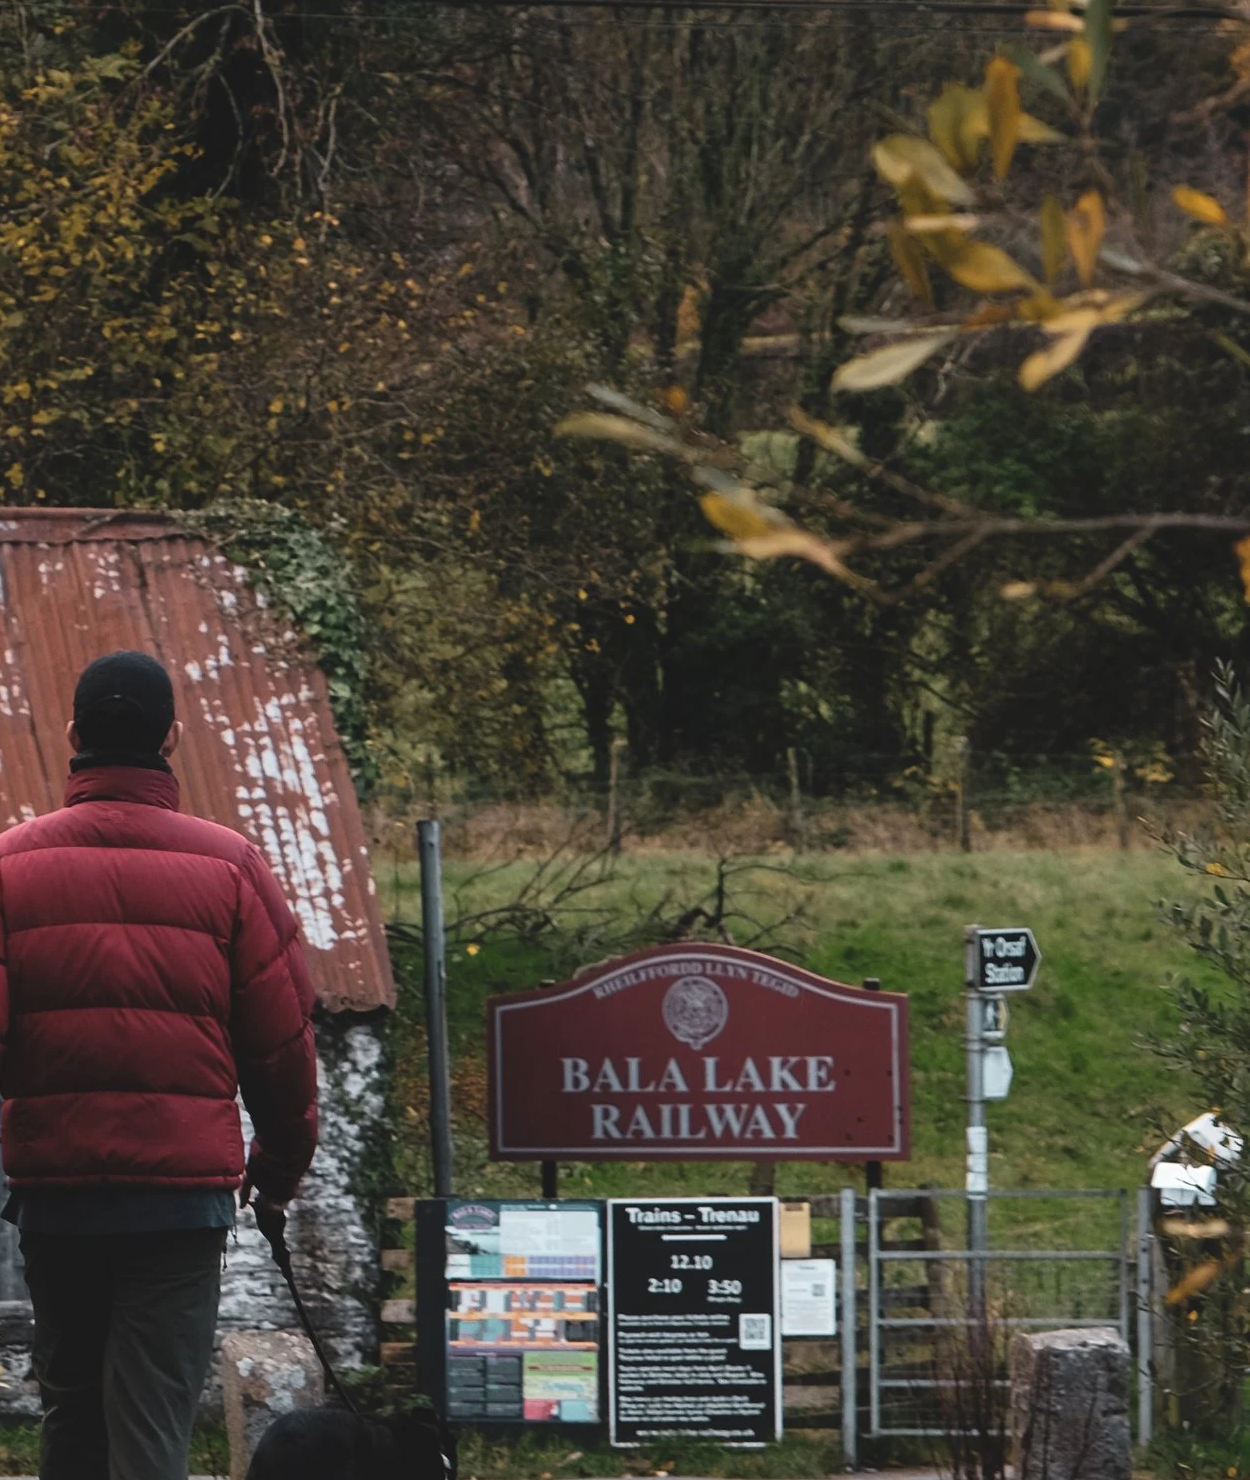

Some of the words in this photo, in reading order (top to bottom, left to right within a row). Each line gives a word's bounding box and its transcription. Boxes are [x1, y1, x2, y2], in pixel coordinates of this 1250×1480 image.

[705, 961, 748, 980] LLYN
[752, 970, 800, 999] TEGID
[984, 962, 1025, 984] Station
[561, 1057, 689, 1093] BALA
[702, 1055, 836, 1092] LAKE
[590, 1103, 807, 1139] RAILWAY
[625, 1207, 683, 1224] Trains
[697, 1206, 760, 1223] Trenau
[670, 1255, 713, 1270] 12.10
[648, 1278, 683, 1294] 2:10
[707, 1279, 742, 1295] 3:50
